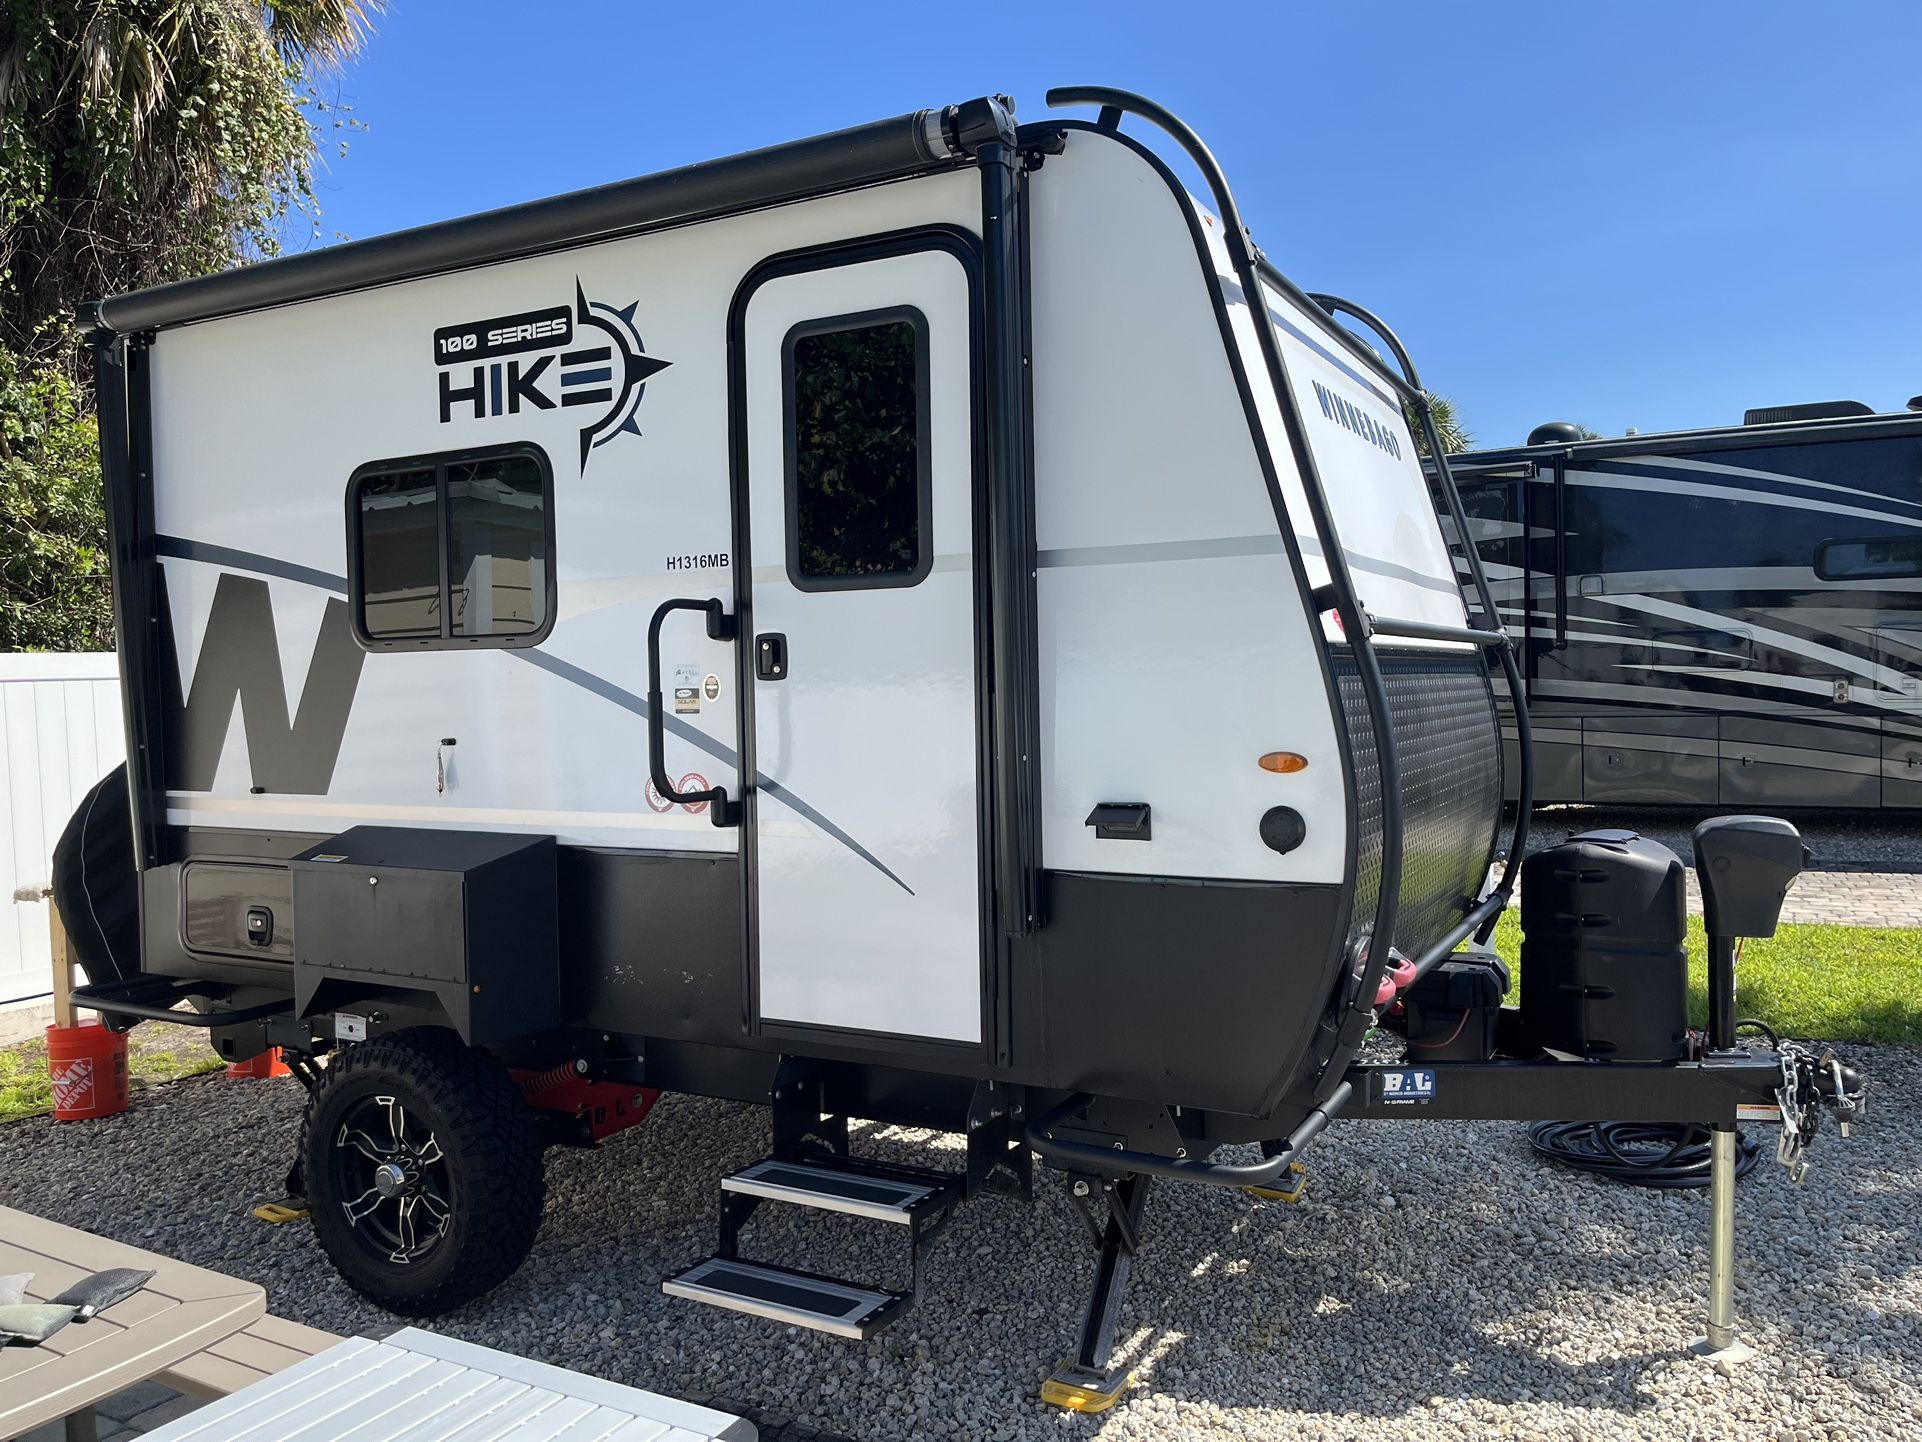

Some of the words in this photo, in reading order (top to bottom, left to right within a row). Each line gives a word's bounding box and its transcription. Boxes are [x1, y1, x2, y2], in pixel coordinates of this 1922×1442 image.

[440, 333, 478, 354] 100
[487, 317, 568, 347] SERIES
[438, 346, 613, 423] HIKE
[1311, 379, 1402, 461] WINNEBAGO
[666, 553, 730, 570] H1316MB
[62, 1076, 93, 1110] DEPOT
[1383, 1072, 1432, 1092] BAL
